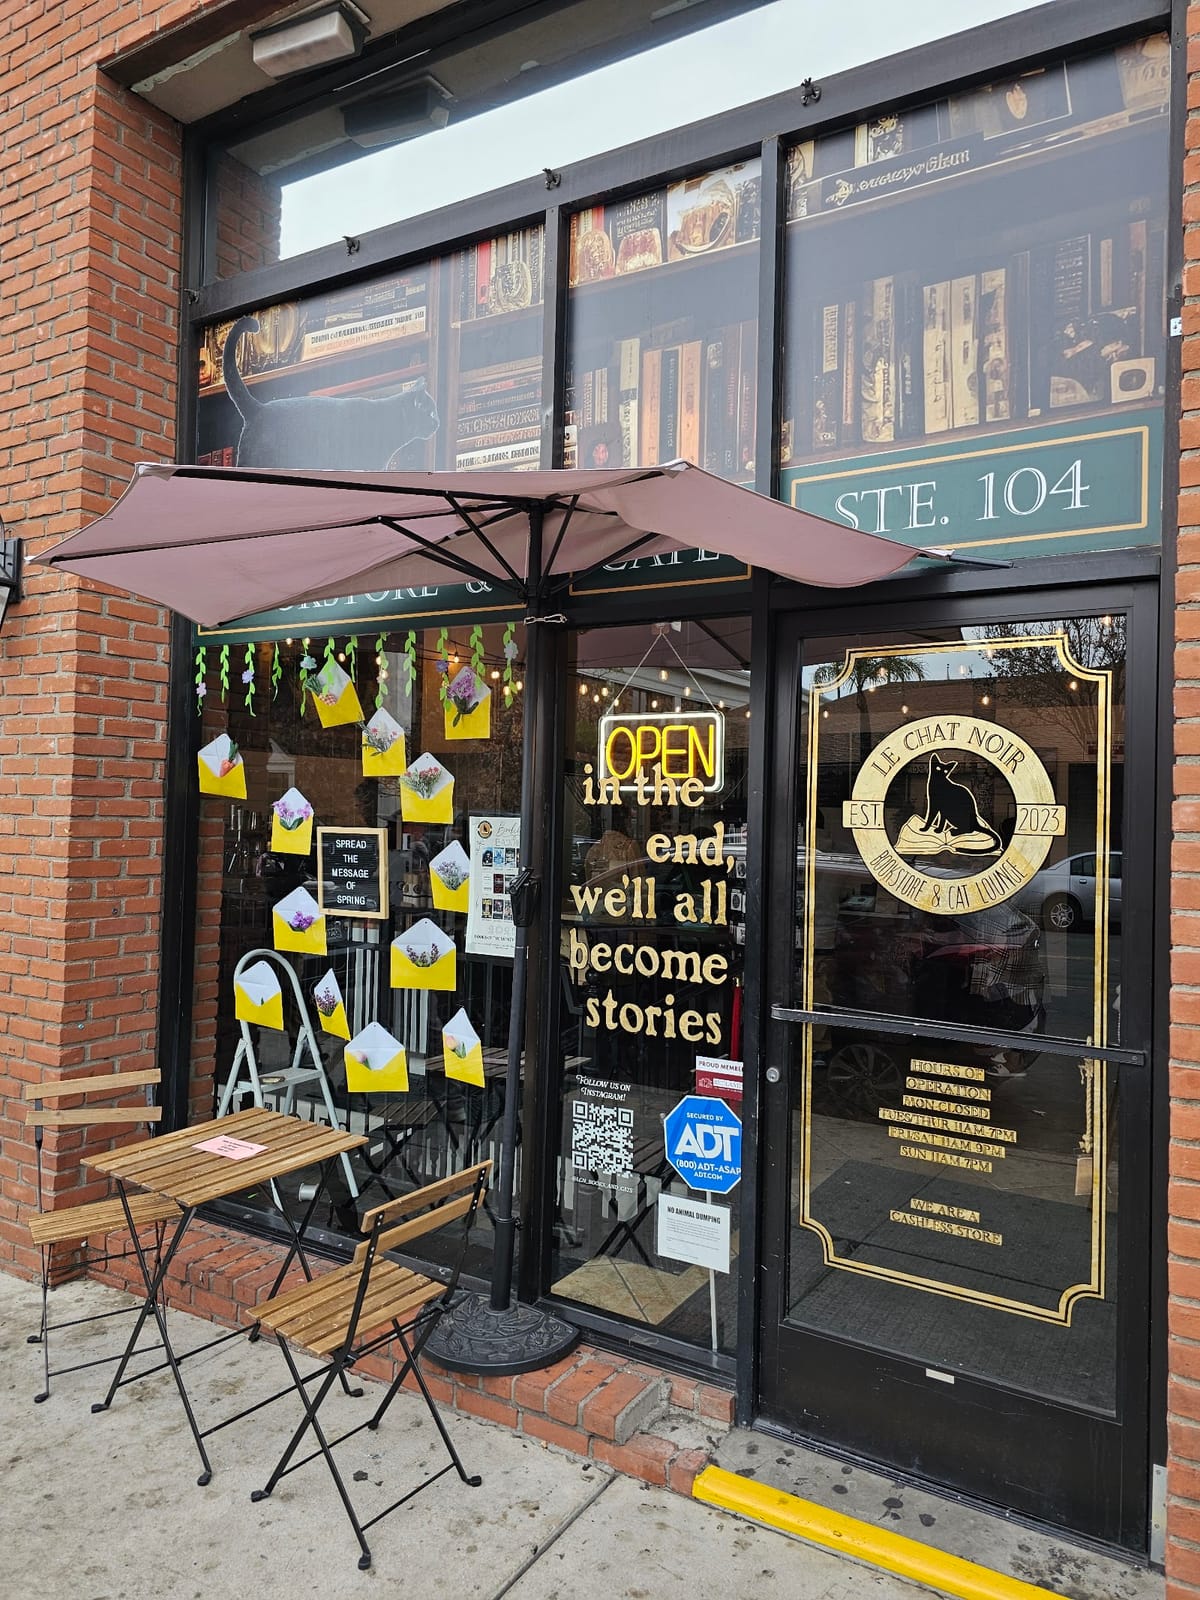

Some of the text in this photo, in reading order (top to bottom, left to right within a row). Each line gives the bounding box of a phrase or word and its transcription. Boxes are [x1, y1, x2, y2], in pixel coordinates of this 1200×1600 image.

[835, 459, 1091, 533] STE. 104
[605, 724, 715, 779] OPEN
[871, 722, 1025, 777] LE CHAT NOIR
[582, 762, 705, 807] in the
[849, 803, 881, 828] EST.
[1018, 807, 1060, 832] 2023
[335, 839, 367, 849] SPREAD
[646, 820, 735, 874] end,
[342, 854, 359, 863] THE
[331, 868, 369, 878] MESSAGE
[869, 850, 1029, 910] BOOKSTORE & CAT LOUNGE
[345, 881, 356, 890] OF
[336, 895, 366, 905] SPRING
[569, 874, 728, 926] we'll all
[569, 928, 729, 985] become
[585, 989, 722, 1045] stories
[698, 1061, 719, 1069] PROUD
[912, 1060, 984, 1081] HOURS OF
[575, 1074, 631, 1092] FOLLOW US ON
[580, 1086, 626, 1101] INSTAGRAM!
[906, 1078, 991, 1101] OPERATION
[686, 1112, 714, 1121] SECURED
[674, 1122, 740, 1162] ADT
[901, 1146, 927, 1159] SUN
[676, 1159, 742, 1175] (800) ADT-ASAP
[675, 1207, 695, 1218] ANIMAL
[695, 1212, 721, 1224] DUMPING
[912, 1199, 978, 1222] WE ARE A
[891, 1211, 1002, 1244] CASHLESS STORE
